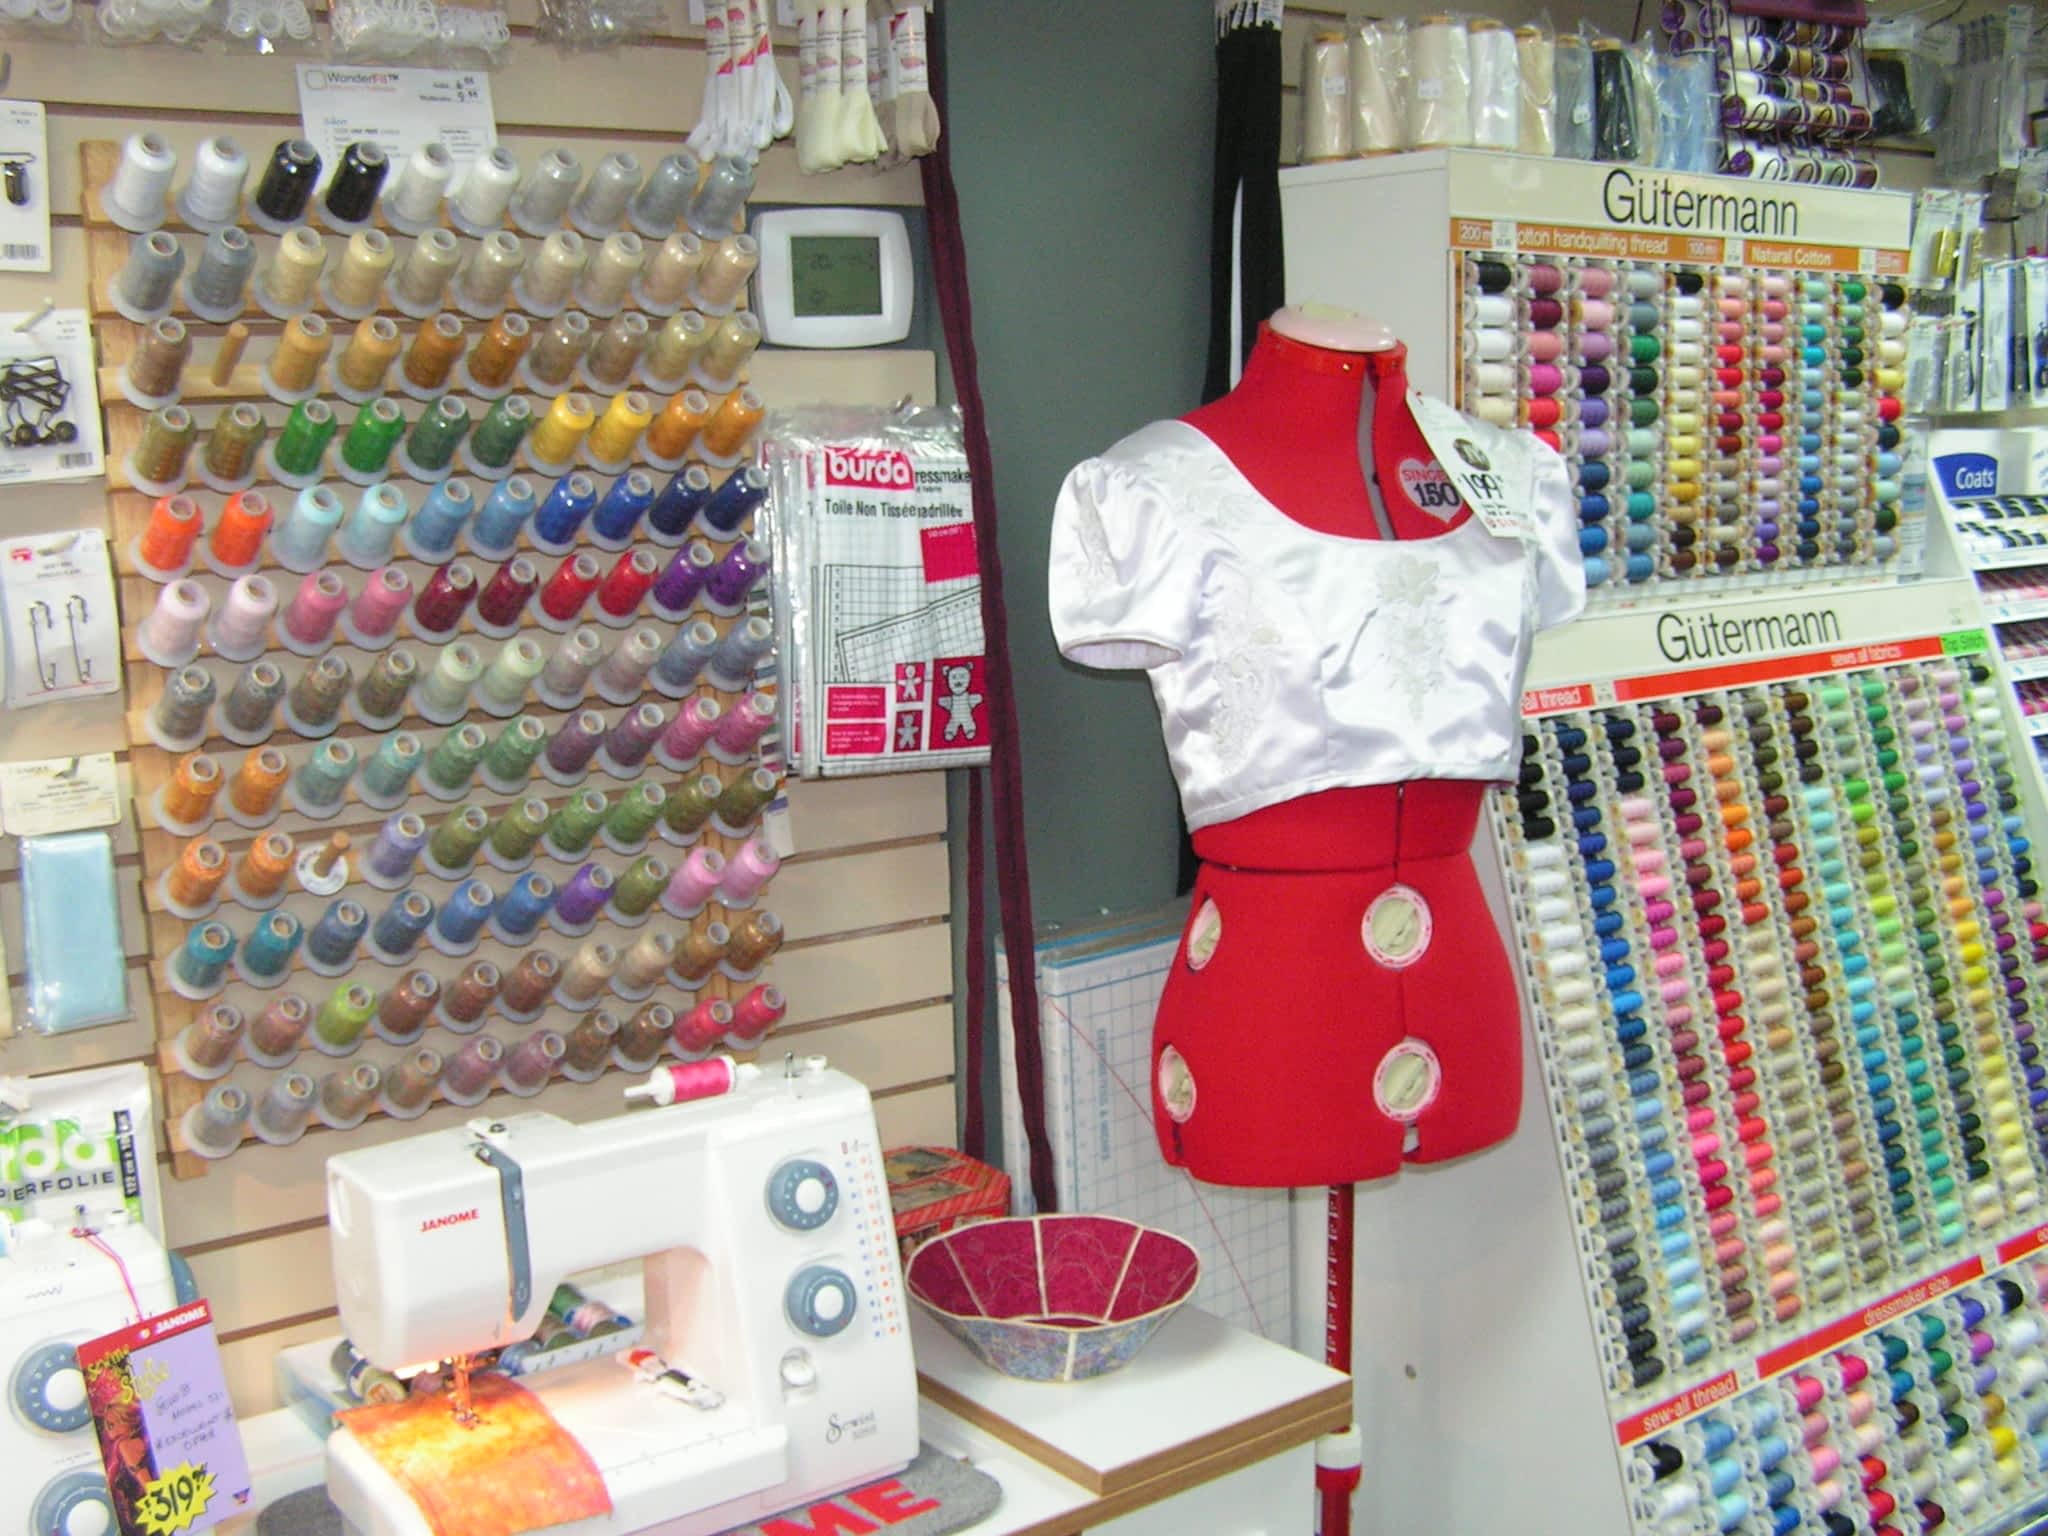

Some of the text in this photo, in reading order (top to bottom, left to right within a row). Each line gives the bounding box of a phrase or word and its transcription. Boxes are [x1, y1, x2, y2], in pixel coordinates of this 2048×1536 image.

[1604, 168, 1798, 236] Gütermann
[1460, 223, 1481, 241] 200
[1517, 227, 1550, 246] otton
[1553, 228, 1628, 255] handquilting
[1630, 234, 1669, 255] thread
[1751, 247, 1832, 267] Natural Cotton
[829, 452, 910, 485] burda
[915, 468, 972, 483] ressmake
[1402, 469, 1447, 482] SINGE
[1955, 467, 1995, 490] Coats
[825, 499, 853, 514] Toile
[856, 501, 877, 517] Non
[917, 502, 963, 518] adrillée
[1414, 482, 1461, 508] 150
[1657, 609, 1841, 663] Gütermann
[1540, 687, 1582, 709] thread
[0, 1171, 115, 1201] PERFOLIE
[421, 1208, 480, 1232] JANOME
[1863, 1275, 1950, 1327] dressmaker size
[155, 1305, 208, 1335] JANOME
[1643, 1373, 1735, 1433] sew-all thread
[759, 1478, 942, 1536] ME
